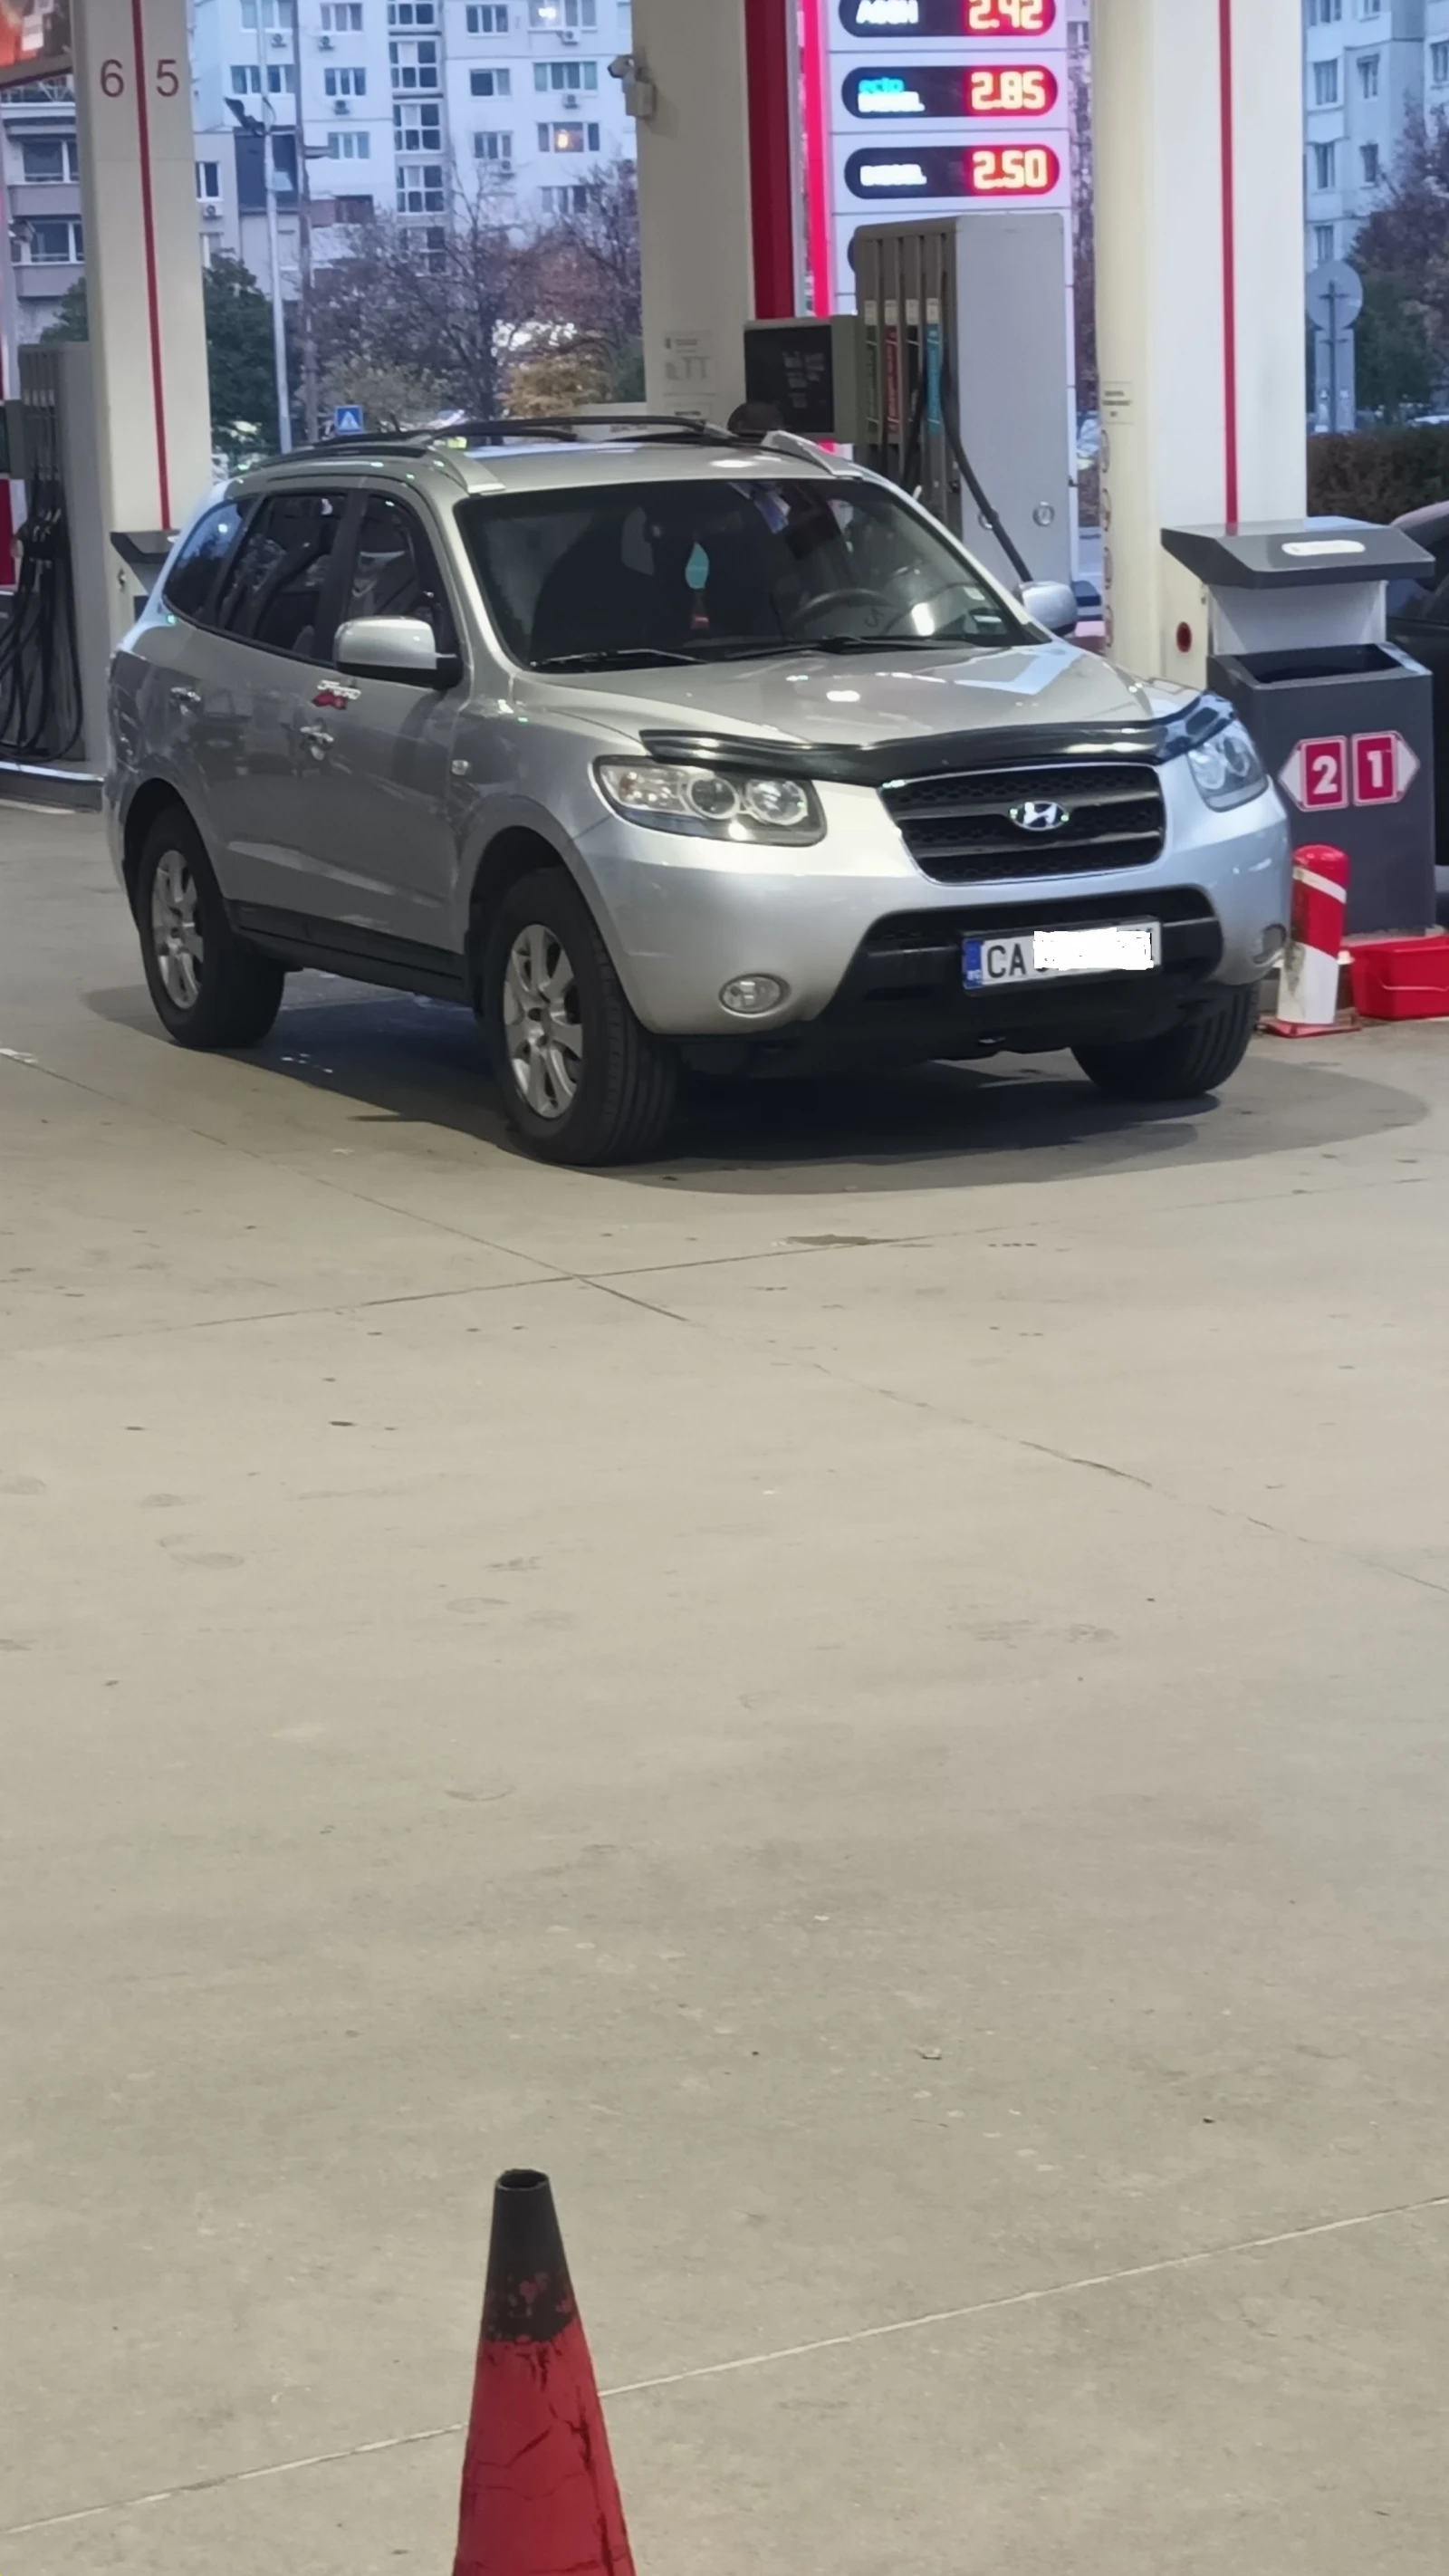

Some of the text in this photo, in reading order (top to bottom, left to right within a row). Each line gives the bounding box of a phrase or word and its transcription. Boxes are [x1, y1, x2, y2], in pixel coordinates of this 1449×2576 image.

[969, 0, 1043, 29] 2.42
[100, 58, 179, 98] 6 5
[971, 71, 1045, 110] 2.85
[973, 149, 1047, 189] 2.50
[1312, 755, 1338, 794] 2
[1367, 750, 1383, 788] 1
[987, 943, 1026, 978] CA
